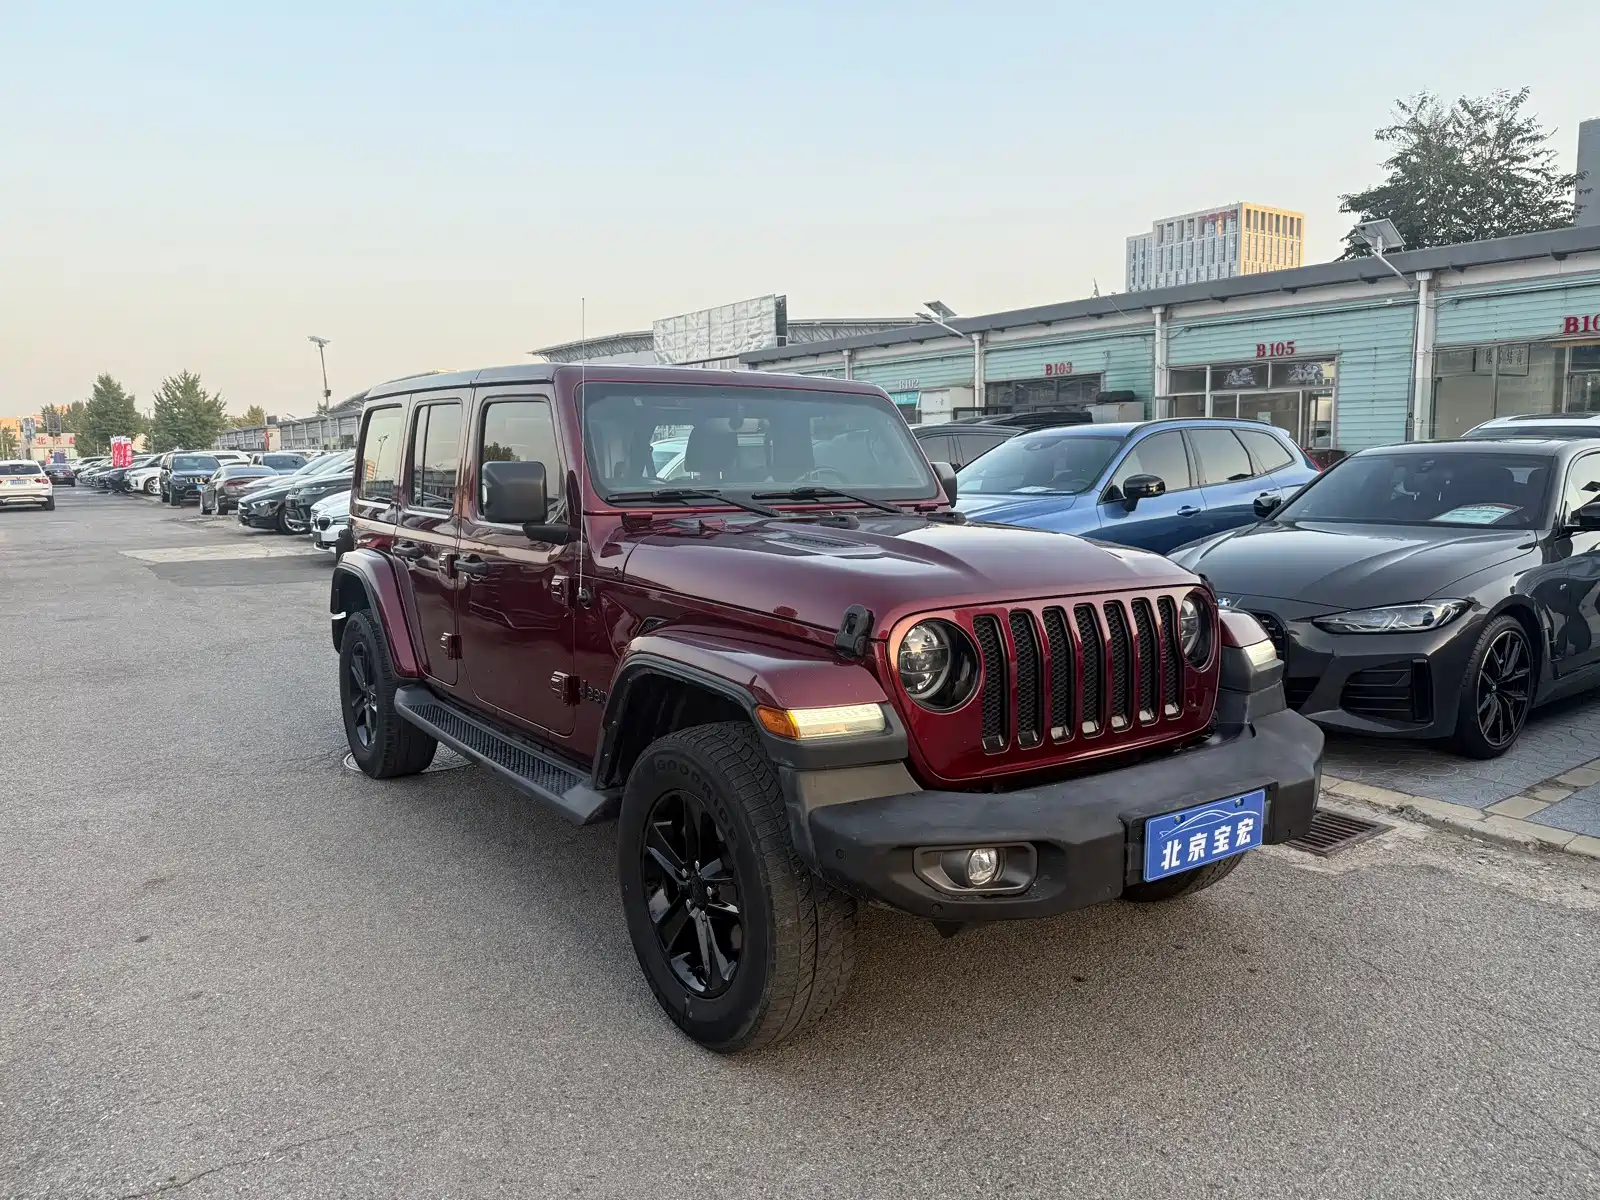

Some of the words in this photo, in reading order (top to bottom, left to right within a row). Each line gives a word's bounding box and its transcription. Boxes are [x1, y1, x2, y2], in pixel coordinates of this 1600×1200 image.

[1256, 341, 1295, 358] B105
[1045, 361, 1073, 376] B103
[899, 379, 919, 389] B102
[1160, 817, 1254, 870] 北京宝宏
